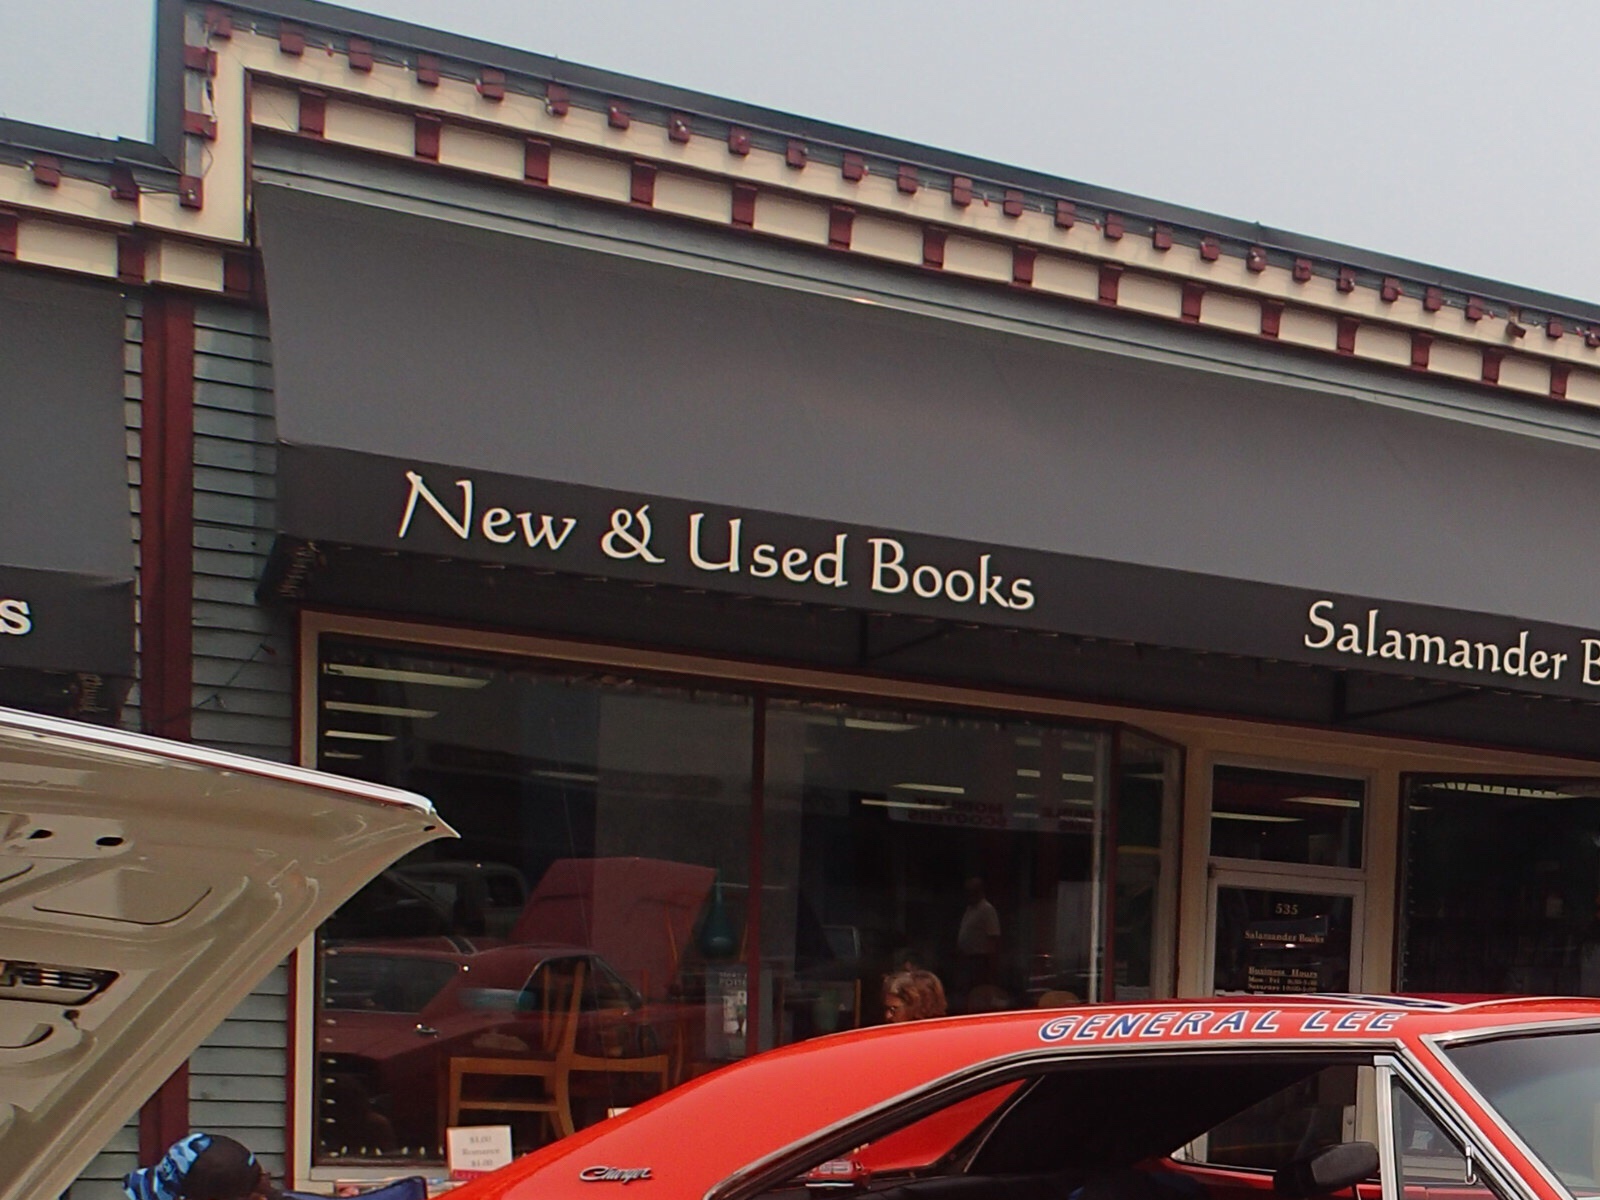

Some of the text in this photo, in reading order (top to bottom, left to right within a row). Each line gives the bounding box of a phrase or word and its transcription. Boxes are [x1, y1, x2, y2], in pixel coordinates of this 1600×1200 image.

[398, 471, 1034, 611] New & Used Books
[1304, 599, 1568, 681] Salamander
[1275, 903, 1299, 915] 535
[1244, 930, 1325, 944] Salamander Books
[1037, 1009, 1409, 1041] GENERAL LEE
